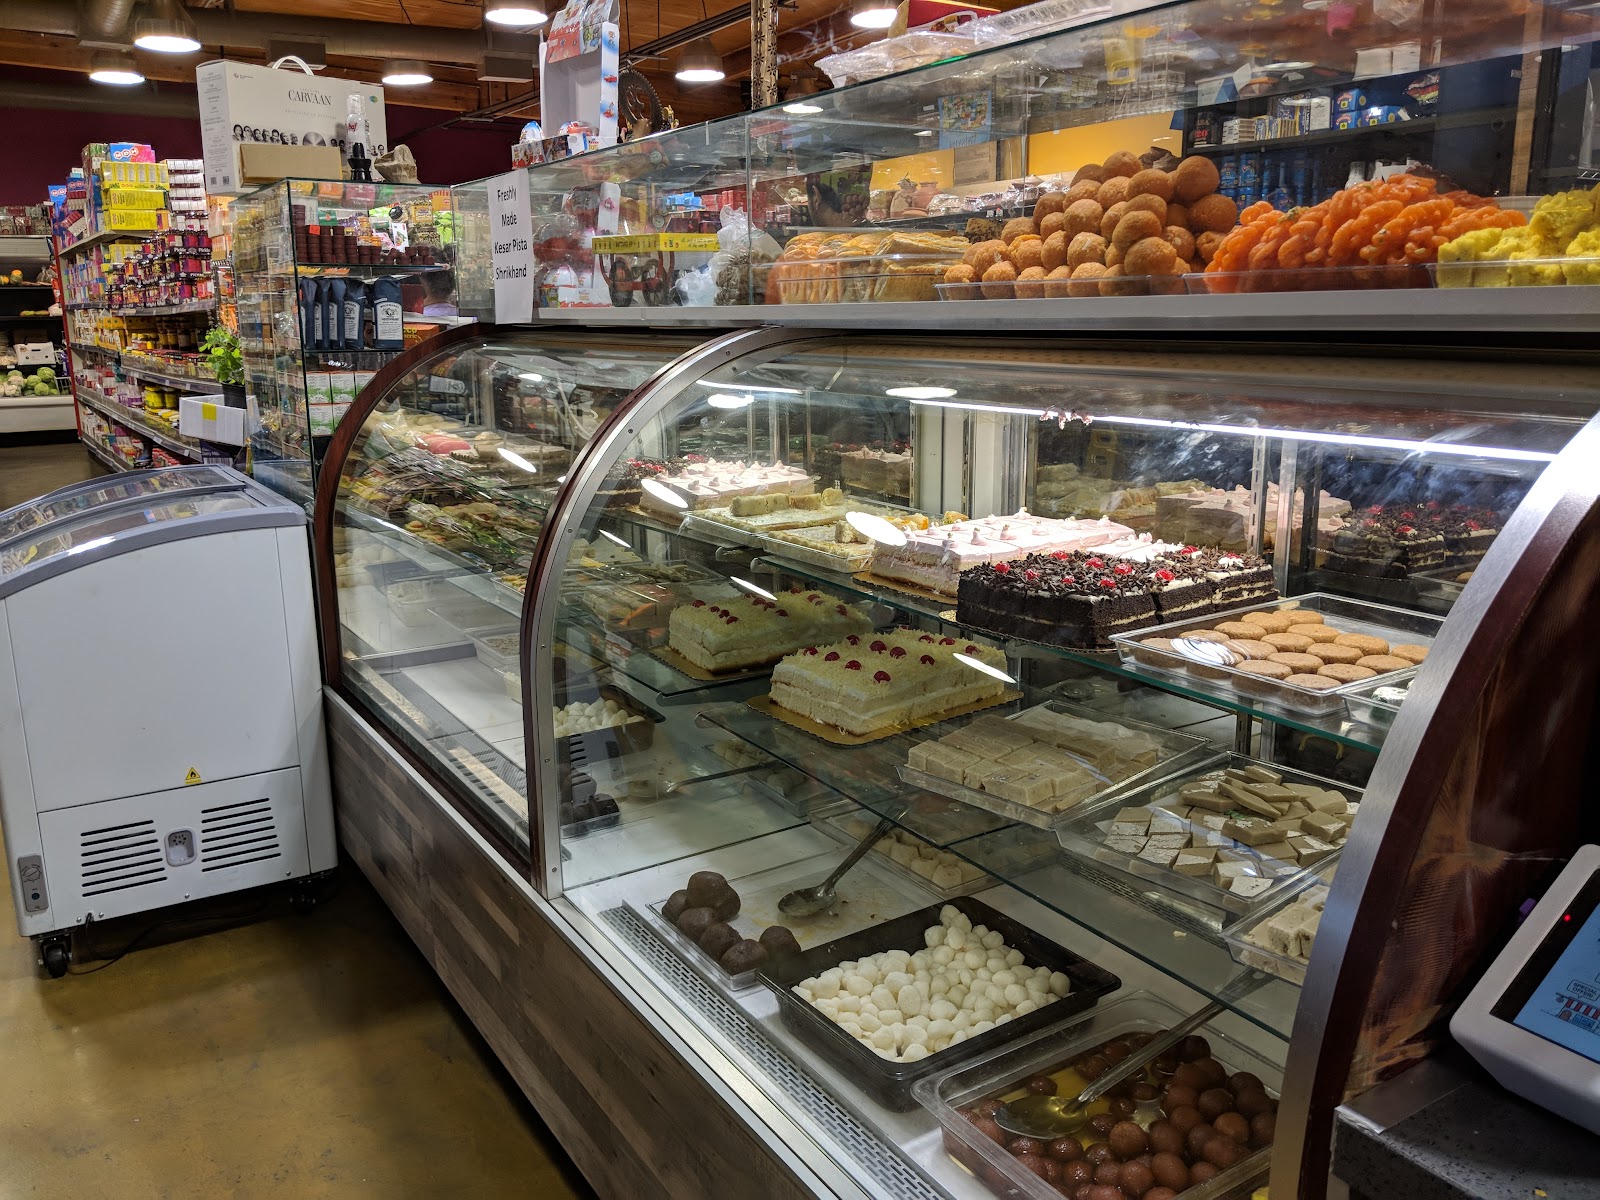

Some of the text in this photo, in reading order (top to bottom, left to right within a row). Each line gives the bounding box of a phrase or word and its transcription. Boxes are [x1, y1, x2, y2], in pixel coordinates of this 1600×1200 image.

[288, 89, 332, 106] CARVAAN
[114, 147, 139, 160] MDH
[497, 185, 517, 202] Freshly
[501, 211, 518, 227] Made
[494, 238, 528, 255] Kesar Pista
[495, 263, 527, 280] Shrikhand
[1573, 982, 1597, 995] SPECIAL
